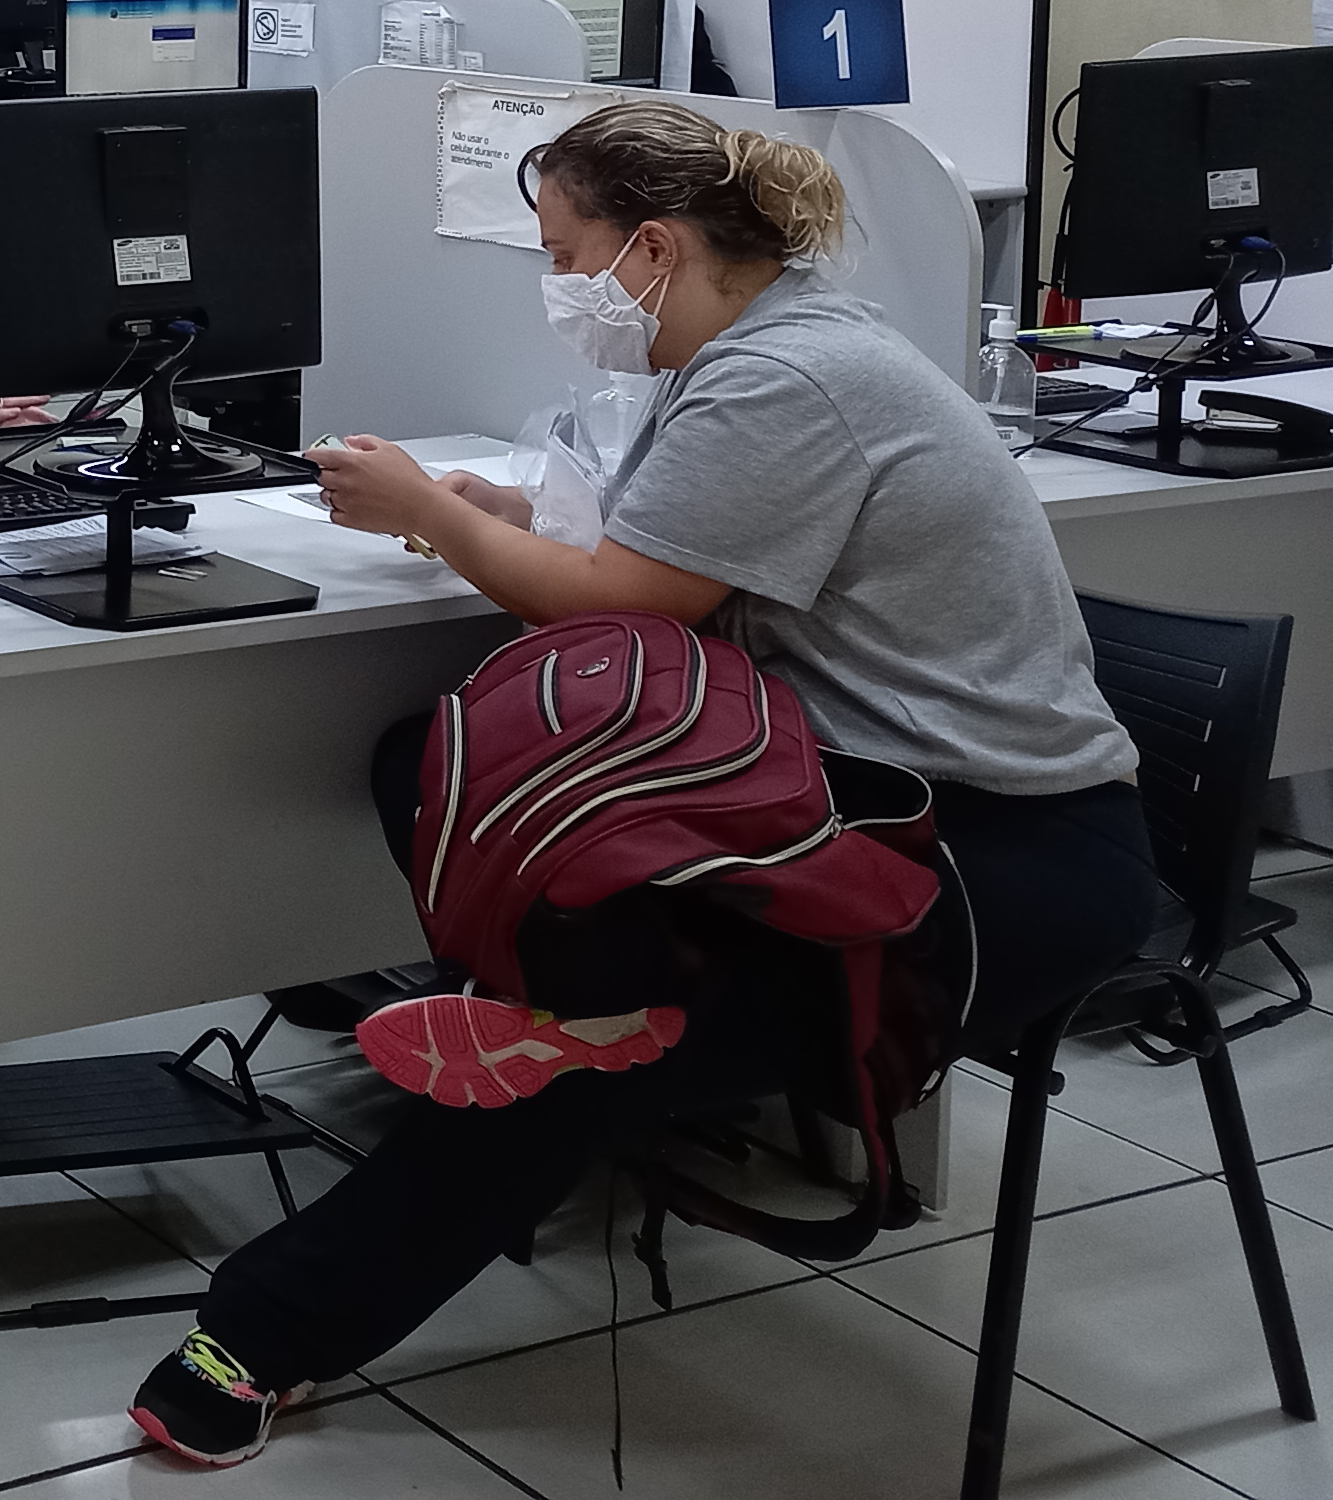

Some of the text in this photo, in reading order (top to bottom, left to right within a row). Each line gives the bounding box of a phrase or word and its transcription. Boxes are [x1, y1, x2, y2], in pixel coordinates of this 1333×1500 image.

[822, 8, 851, 80] 1
[491, 98, 545, 117] ATENÇÃO
[451, 130, 466, 142] Não
[467, 134, 483, 145] usar
[474, 146, 502, 159] durante
